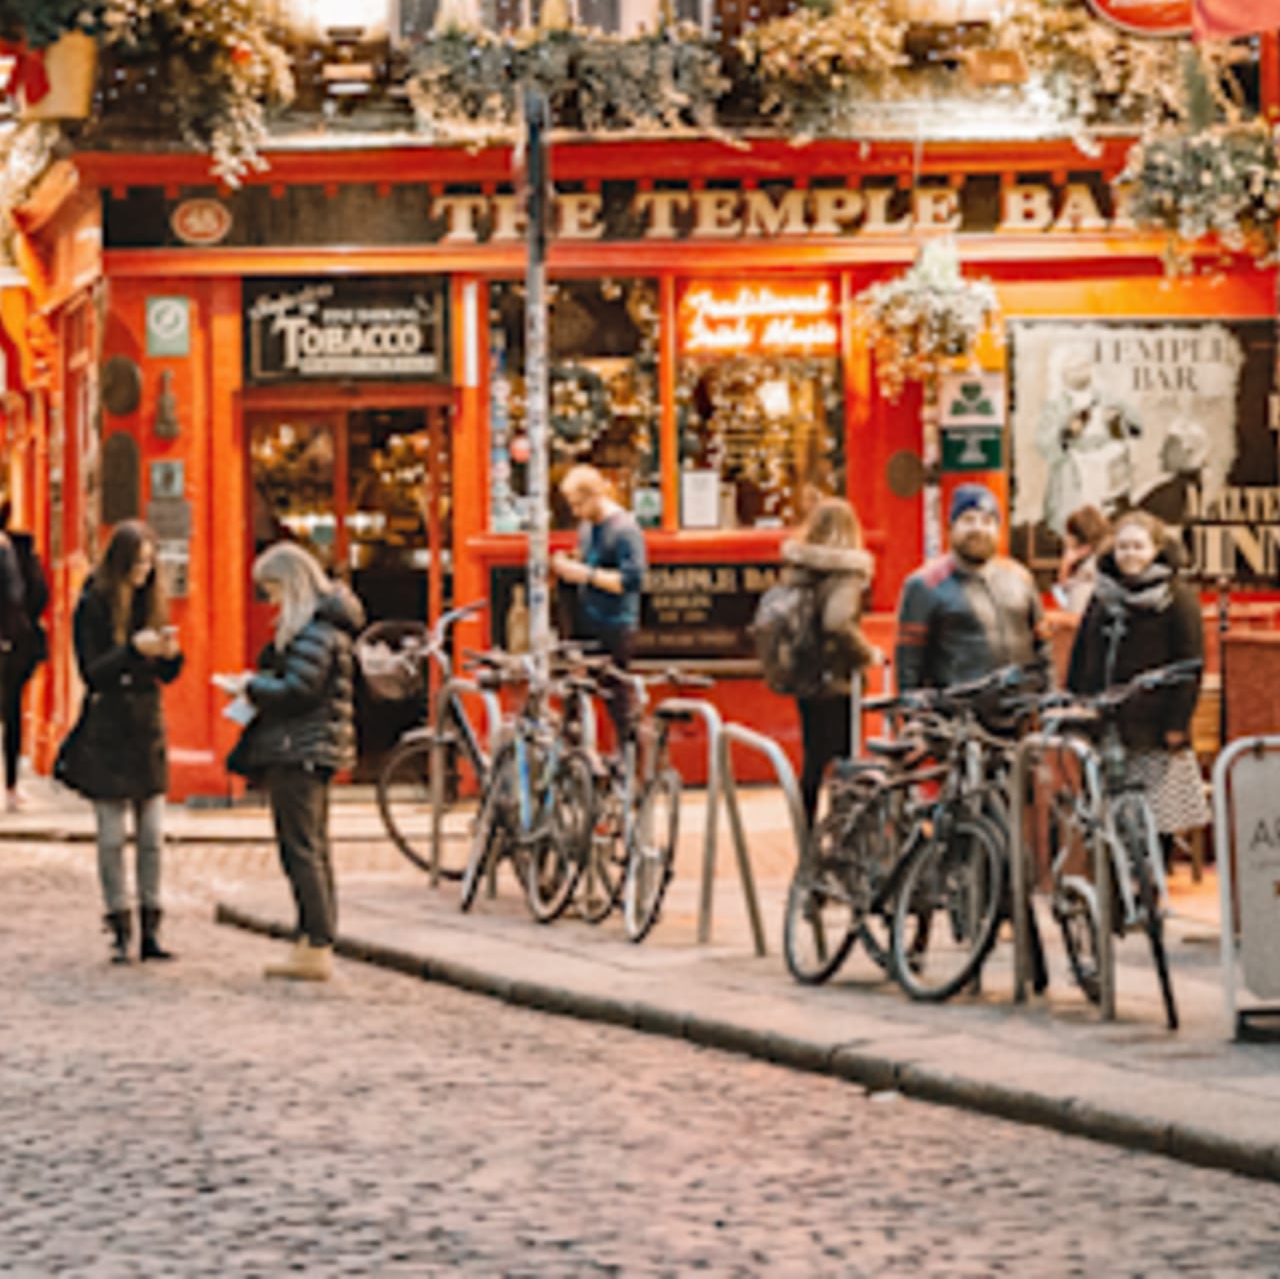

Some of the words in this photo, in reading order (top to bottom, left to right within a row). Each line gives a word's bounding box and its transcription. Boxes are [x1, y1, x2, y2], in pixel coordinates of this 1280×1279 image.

[632, 185, 963, 240] TEMPLE
[271, 317, 423, 369] TOBACCO
[1092, 337, 1228, 364] TEMPLE
[1131, 366, 1199, 392] BAR
[643, 568, 737, 593] EMPLE
